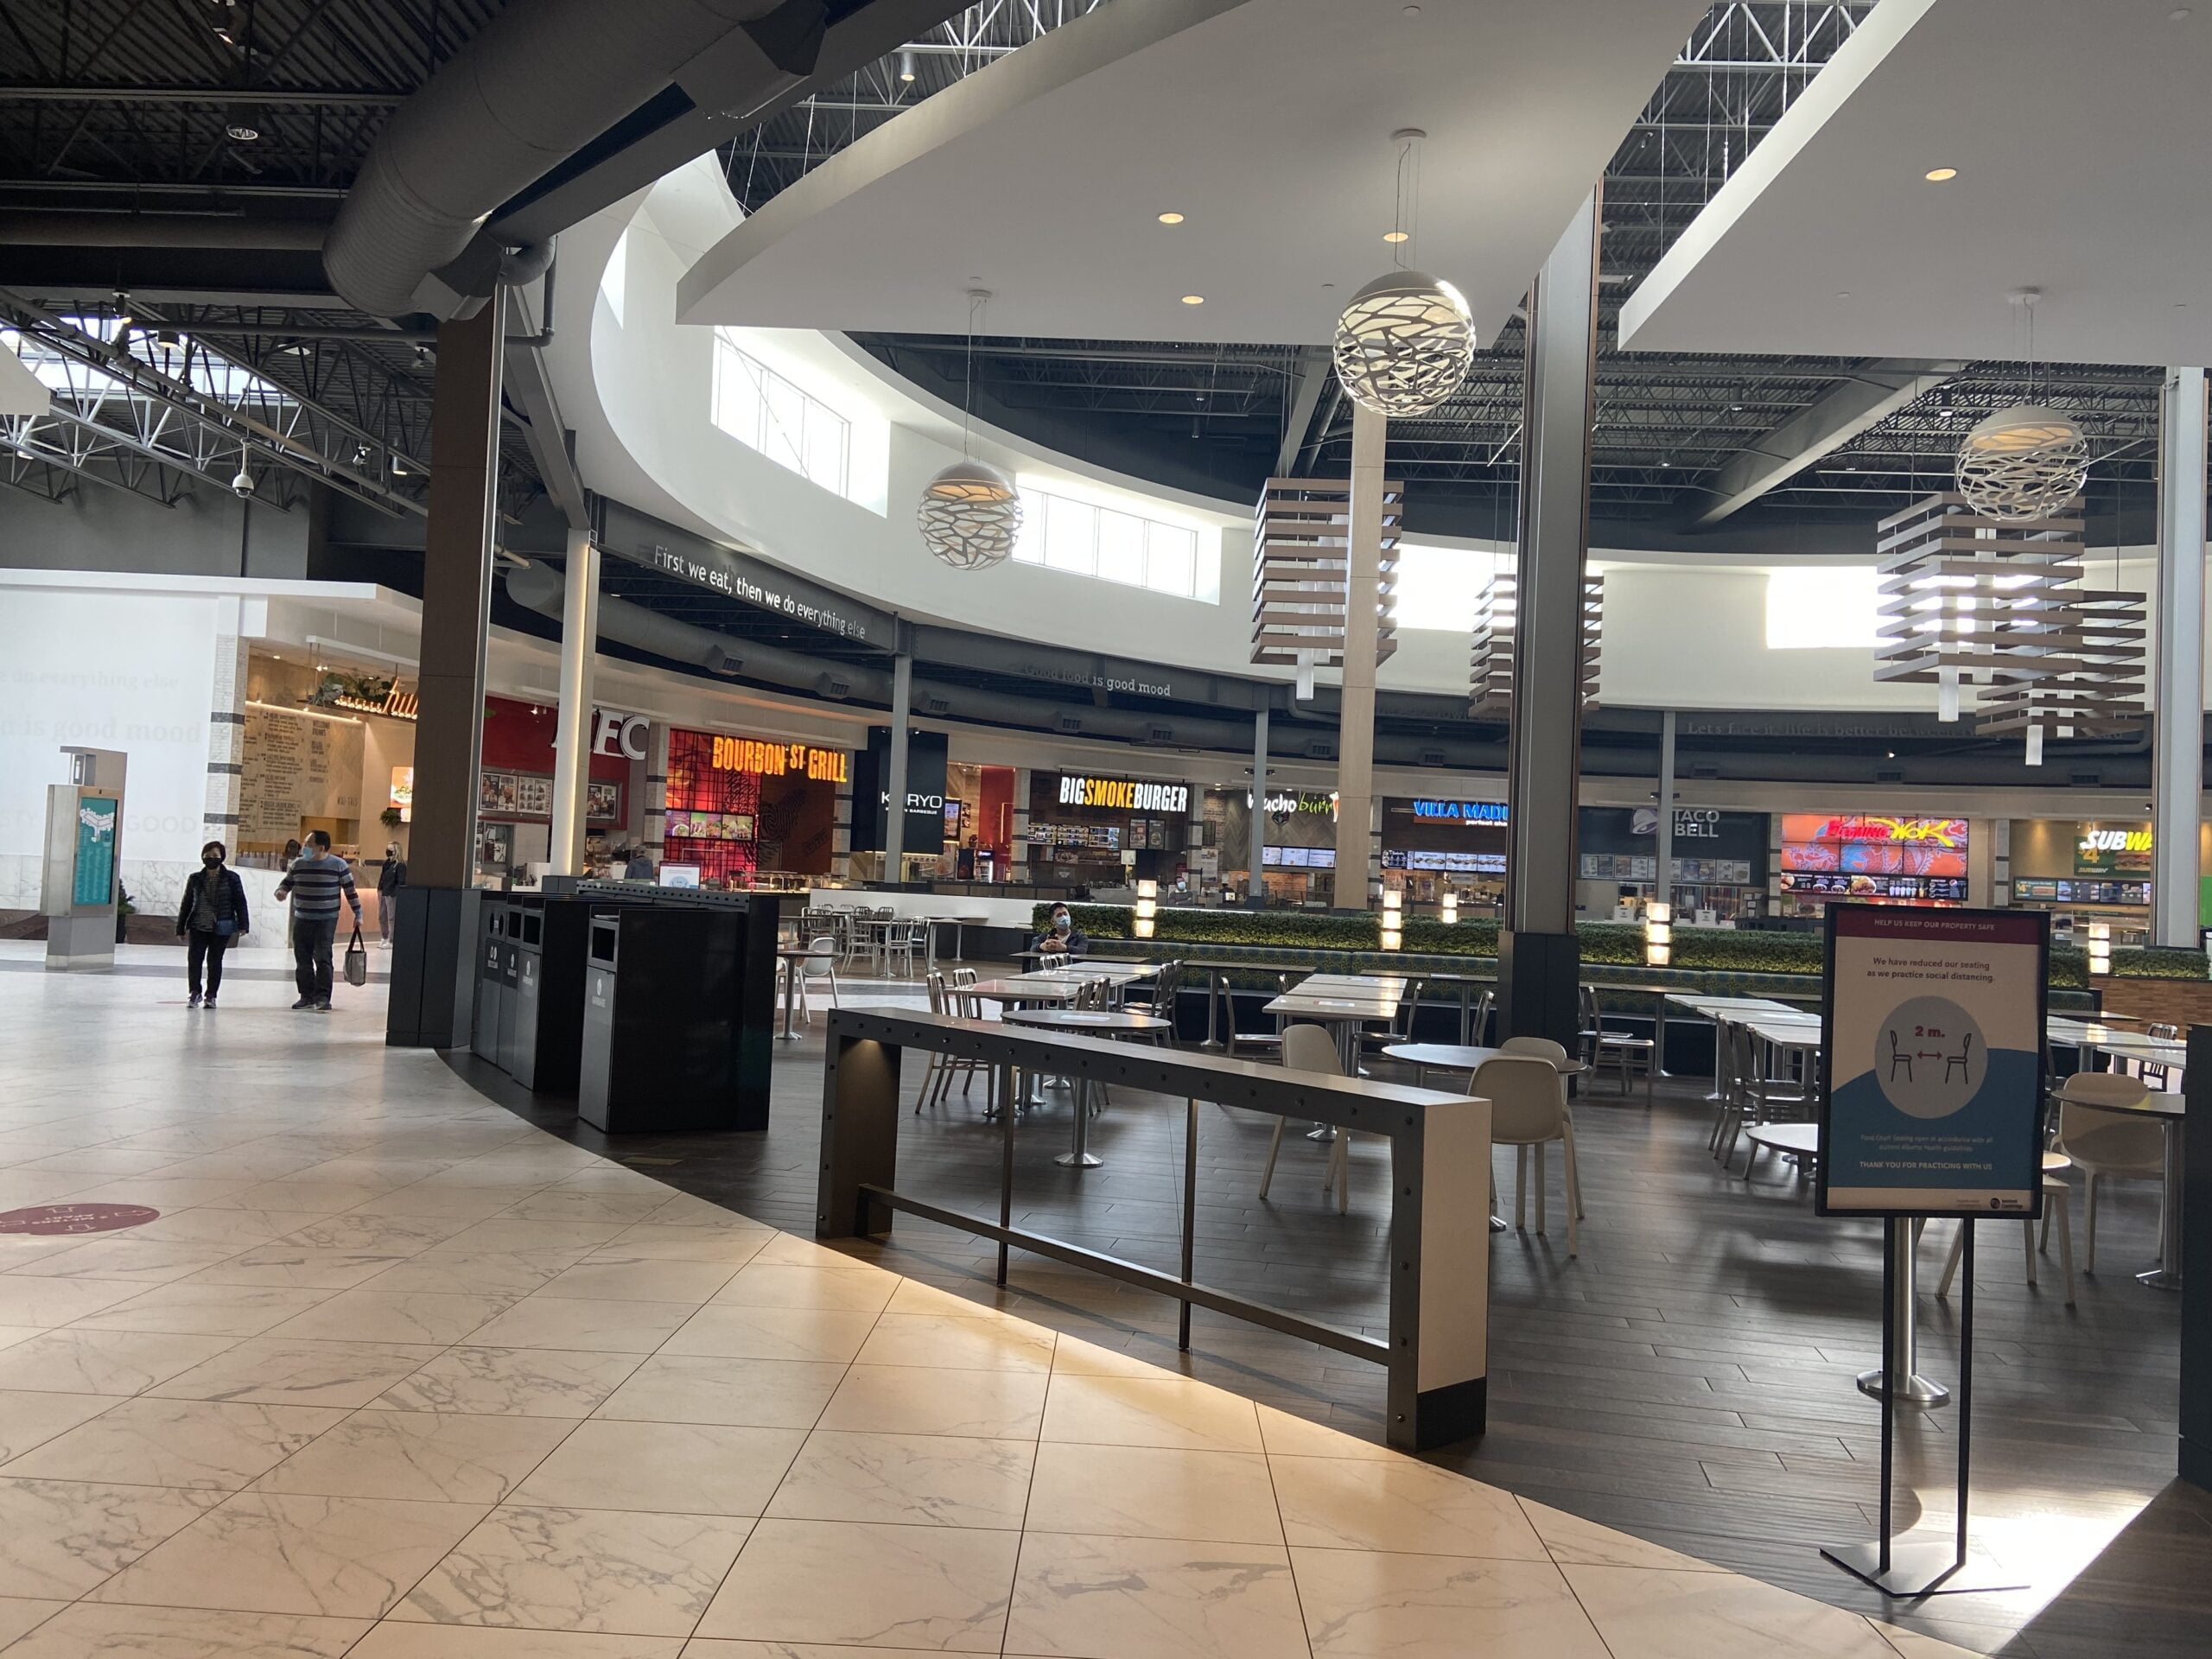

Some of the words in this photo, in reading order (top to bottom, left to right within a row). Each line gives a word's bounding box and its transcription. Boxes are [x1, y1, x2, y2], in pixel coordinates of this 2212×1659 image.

[654, 544, 684, 575] First
[688, 561, 707, 582] we
[709, 569, 733, 594] eat,
[736, 577, 762, 602] then
[765, 590, 781, 608] we
[783, 594, 795, 613] do
[797, 605, 846, 636] everything
[847, 621, 866, 639] else
[1025, 663, 1058, 679] Good
[1092, 672, 1103, 686] is
[1106, 678, 1135, 691] good
[1138, 683, 1172, 697] mood
[551, 708, 651, 761] FC
[712, 736, 785, 776] BOURBON
[790, 744, 806, 769] ST
[808, 748, 848, 783] GRILL
[881, 791, 942, 809] KRYO
[1414, 801, 1459, 818] VILLA
[1463, 803, 1508, 820] MADI
[1672, 809, 1720, 823] TACO
[1674, 823, 1719, 838] BELL
[2079, 830, 2152, 851] SUBWA
[1873, 957, 1886, 965] We
[1888, 957, 1908, 965] have
[1910, 958, 1943, 967] reduced
[1961, 960, 1990, 971] seating
[1891, 969, 1923, 980] practice
[1925, 970, 1948, 979] social
[1915, 1025, 1924, 1037] 2
[1928, 1028, 1946, 1038] m.
[1918, 1161, 1961, 1170] PRACTICING
